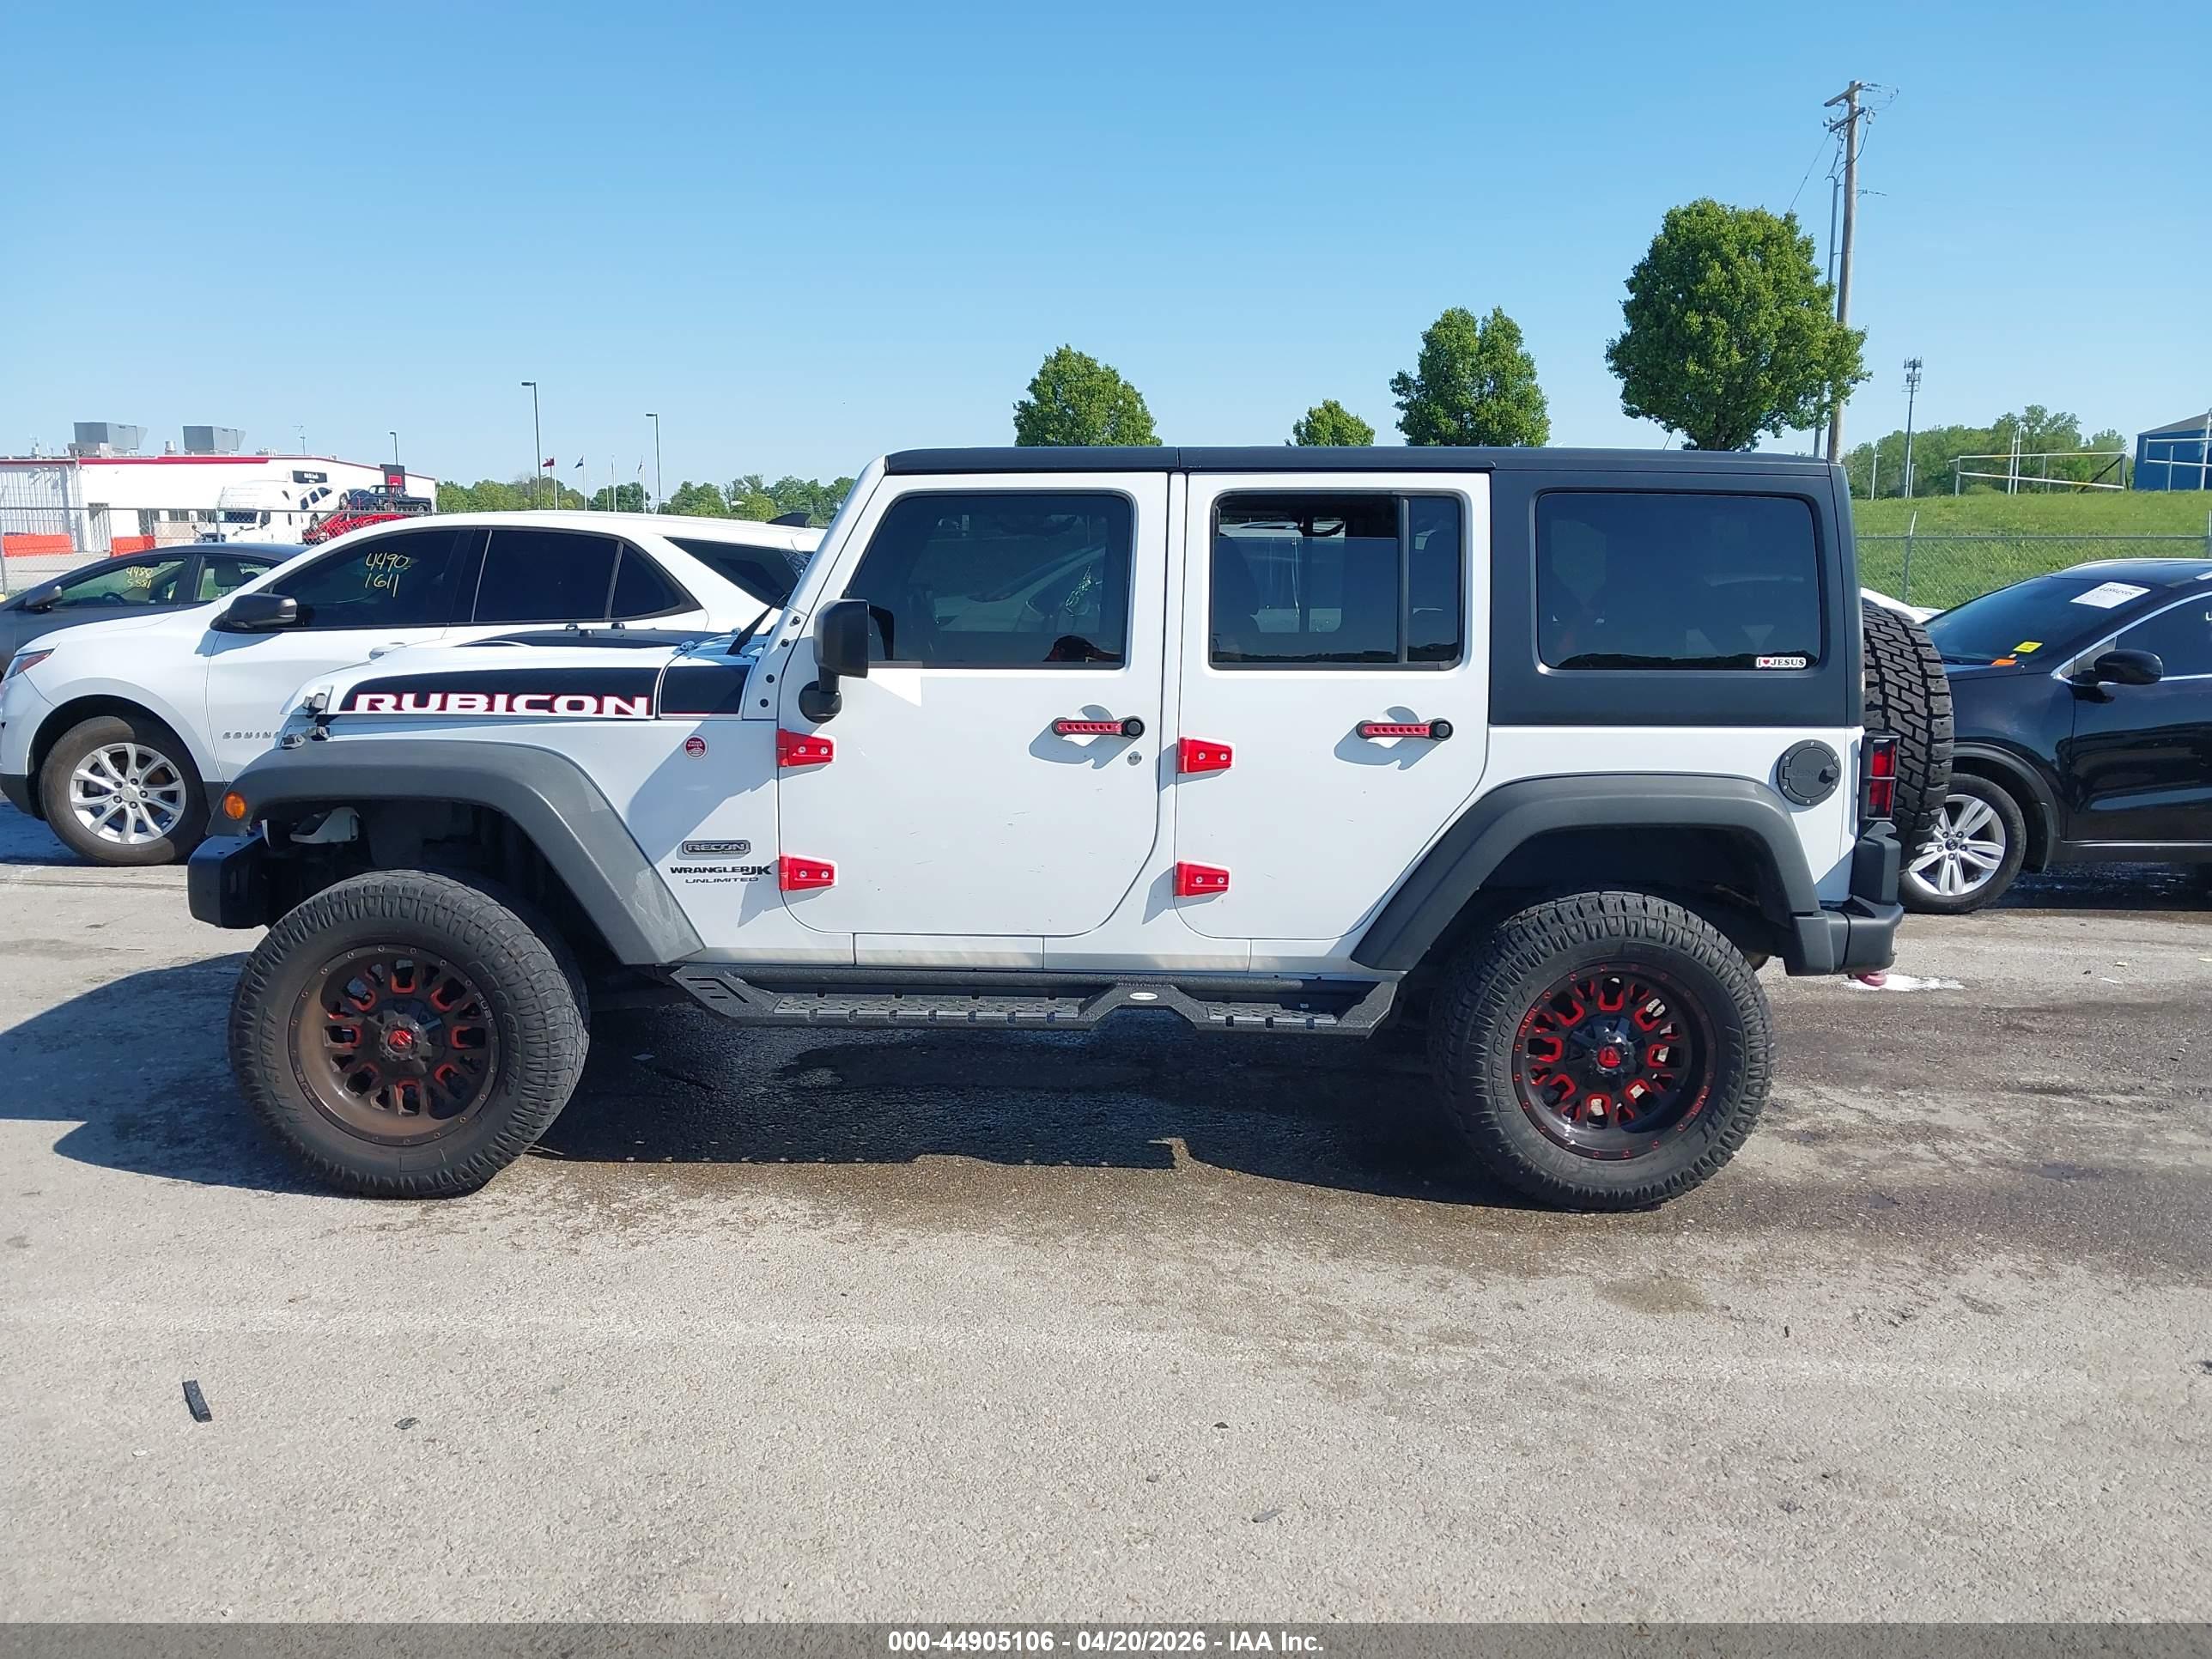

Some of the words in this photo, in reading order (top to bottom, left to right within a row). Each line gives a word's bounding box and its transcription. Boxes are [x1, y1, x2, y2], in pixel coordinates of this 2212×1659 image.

[364, 572, 399, 598] 1611
[354, 692, 650, 716] RUBICON
[687, 843, 744, 852] RECON
[474, 992, 495, 1028] FUEL
